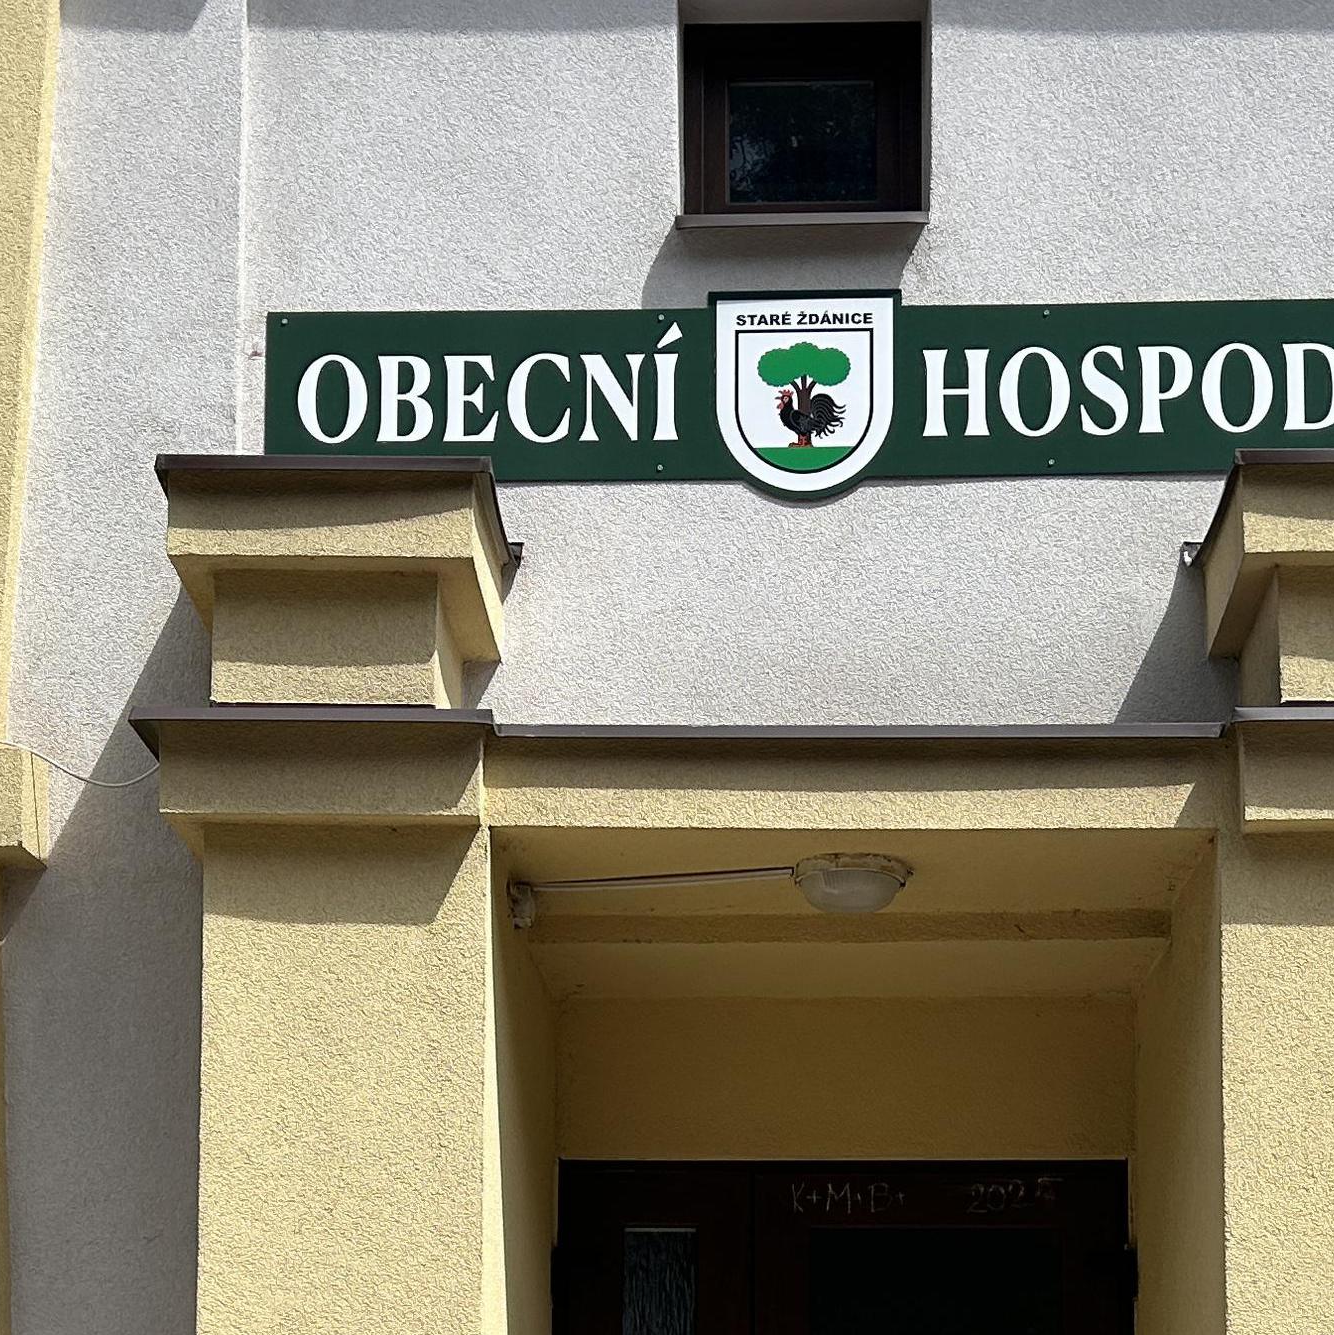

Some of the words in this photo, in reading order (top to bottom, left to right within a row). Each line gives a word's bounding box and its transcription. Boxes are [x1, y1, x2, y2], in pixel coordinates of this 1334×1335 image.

[736, 311, 792, 326] STARÉ
[796, 310, 874, 326] ŽDÁNICE
[297, 321, 684, 444] OBECNÍ
